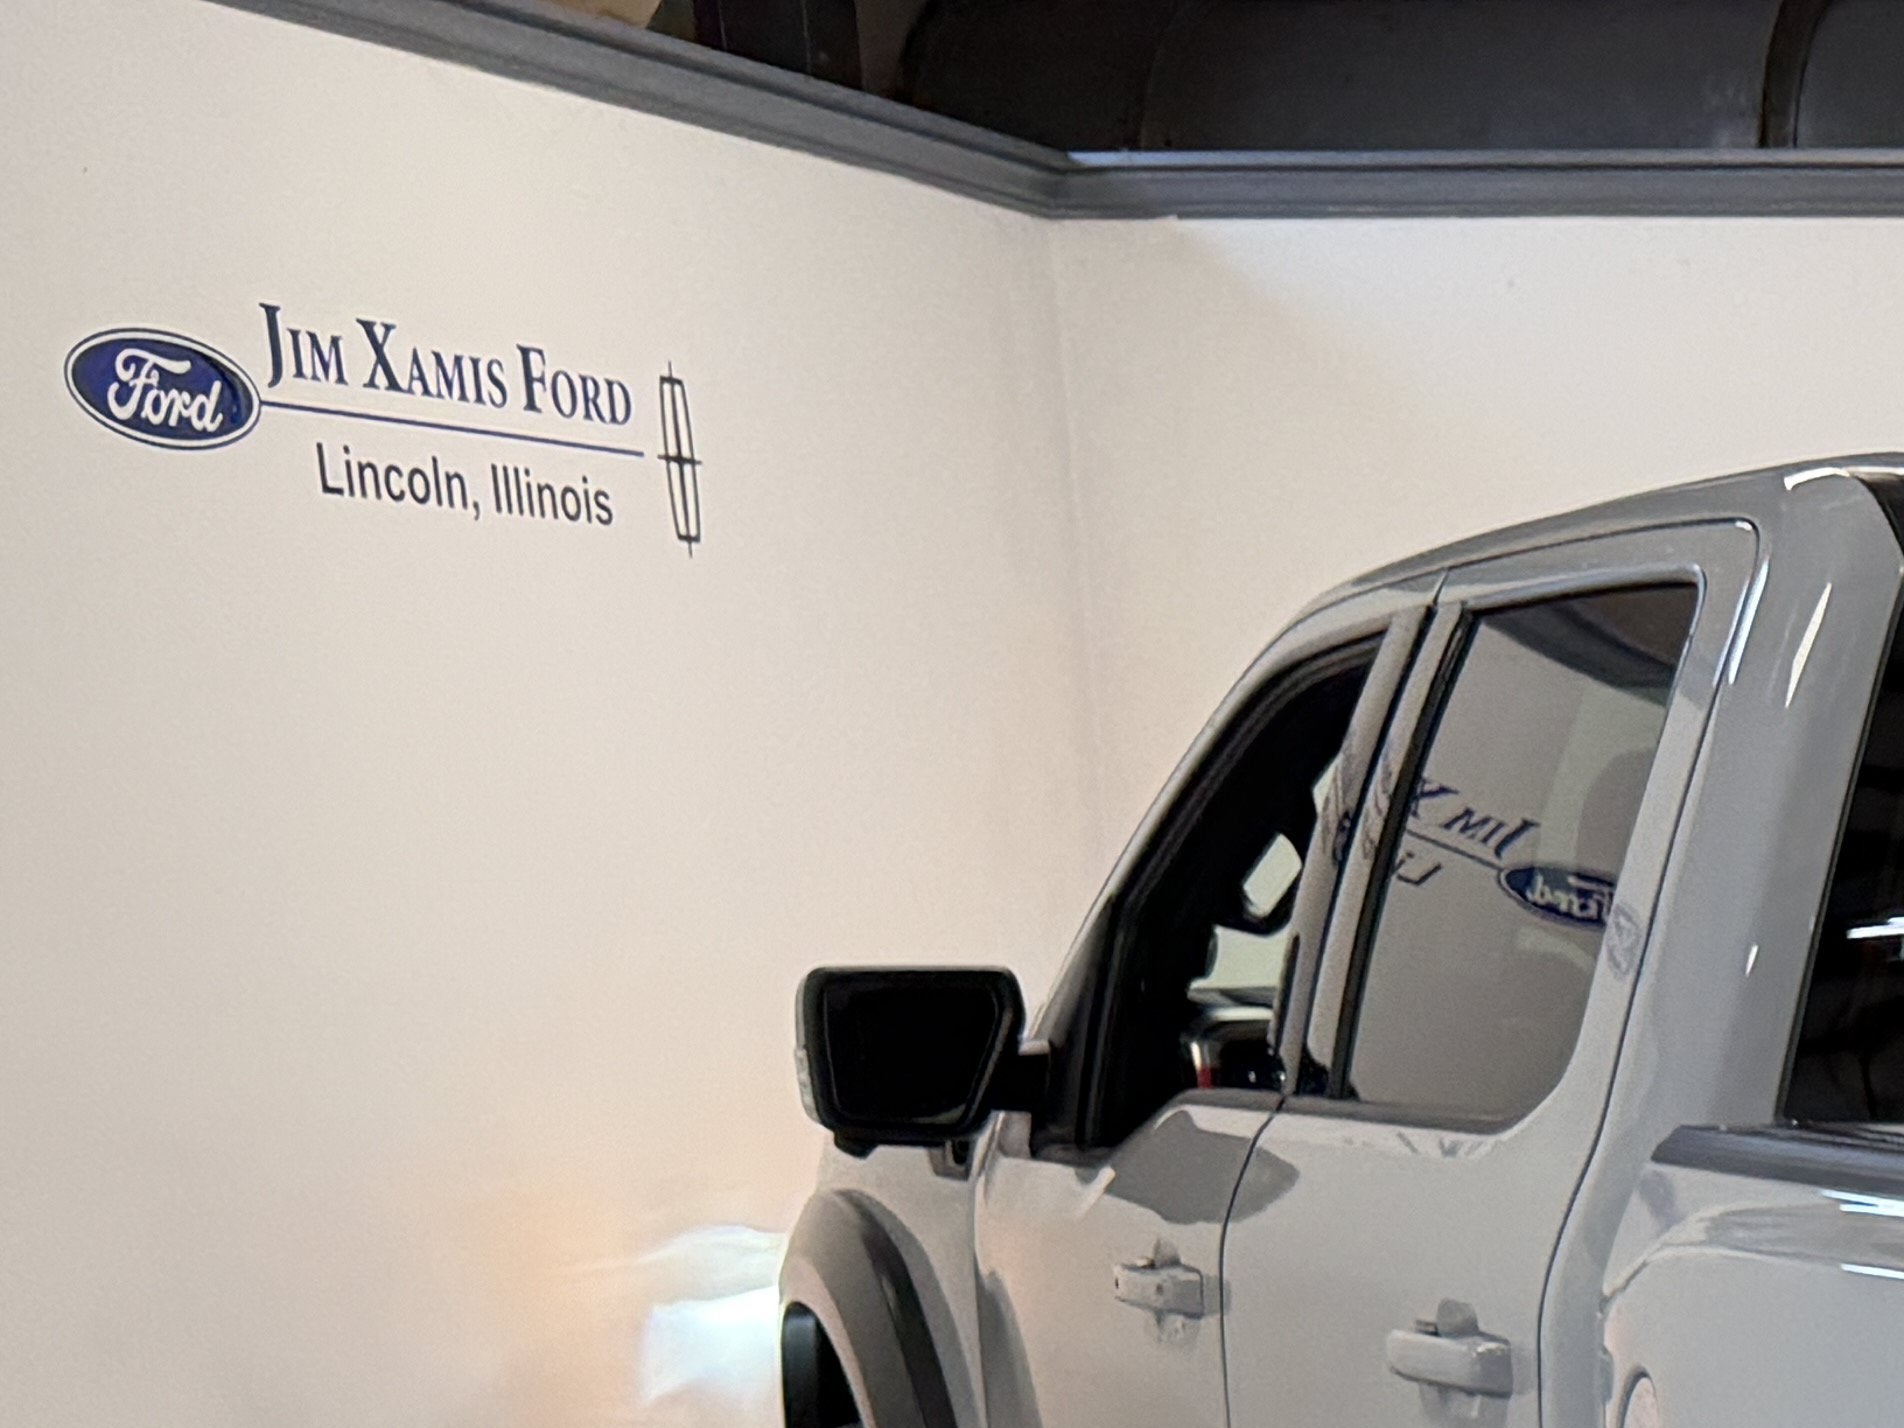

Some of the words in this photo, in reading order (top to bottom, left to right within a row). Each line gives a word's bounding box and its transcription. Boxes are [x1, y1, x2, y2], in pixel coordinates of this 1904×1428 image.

[107, 348, 224, 433] Ford
[315, 442, 482, 521] Lincoln,
[490, 462, 616, 526] Illinois
